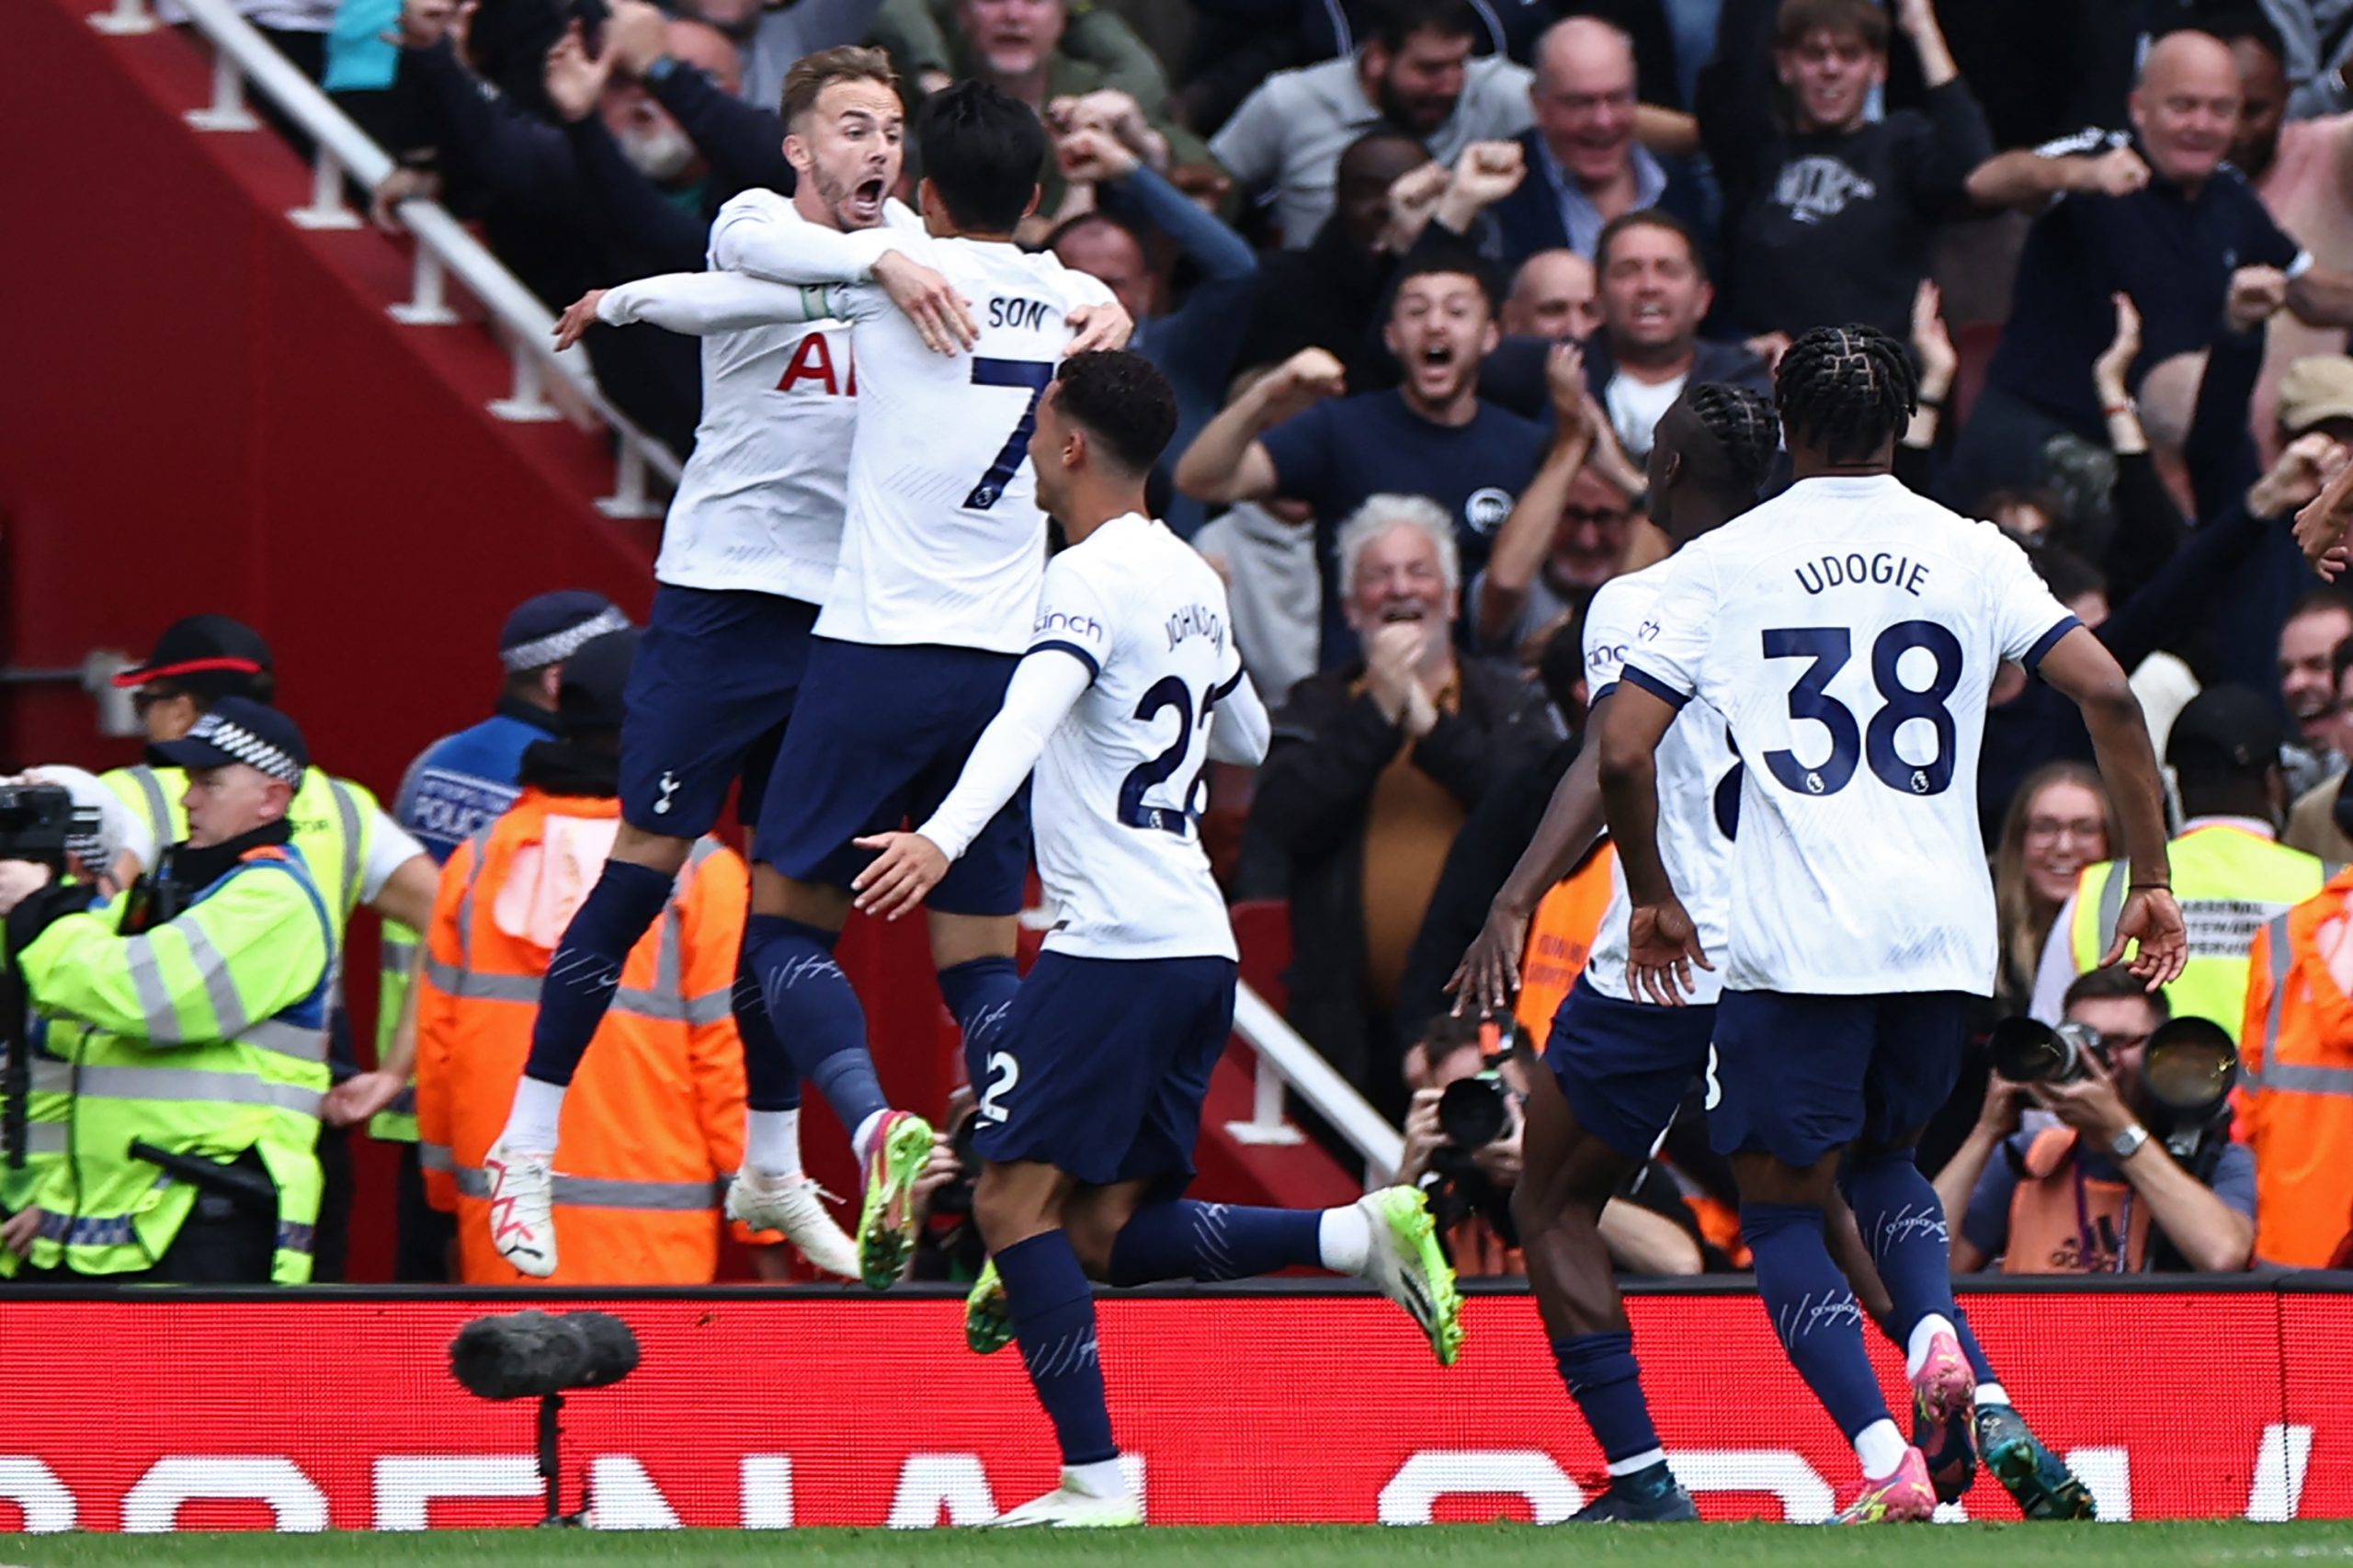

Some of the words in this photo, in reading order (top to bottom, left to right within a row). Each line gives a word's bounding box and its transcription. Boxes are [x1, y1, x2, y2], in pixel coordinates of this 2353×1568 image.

[987, 297, 1050, 332] SON
[961, 356, 1055, 511] 7
[1794, 552, 1930, 597] UDOGIE
[1761, 619, 1963, 797] 38
[414, 794, 495, 835] POLIC
